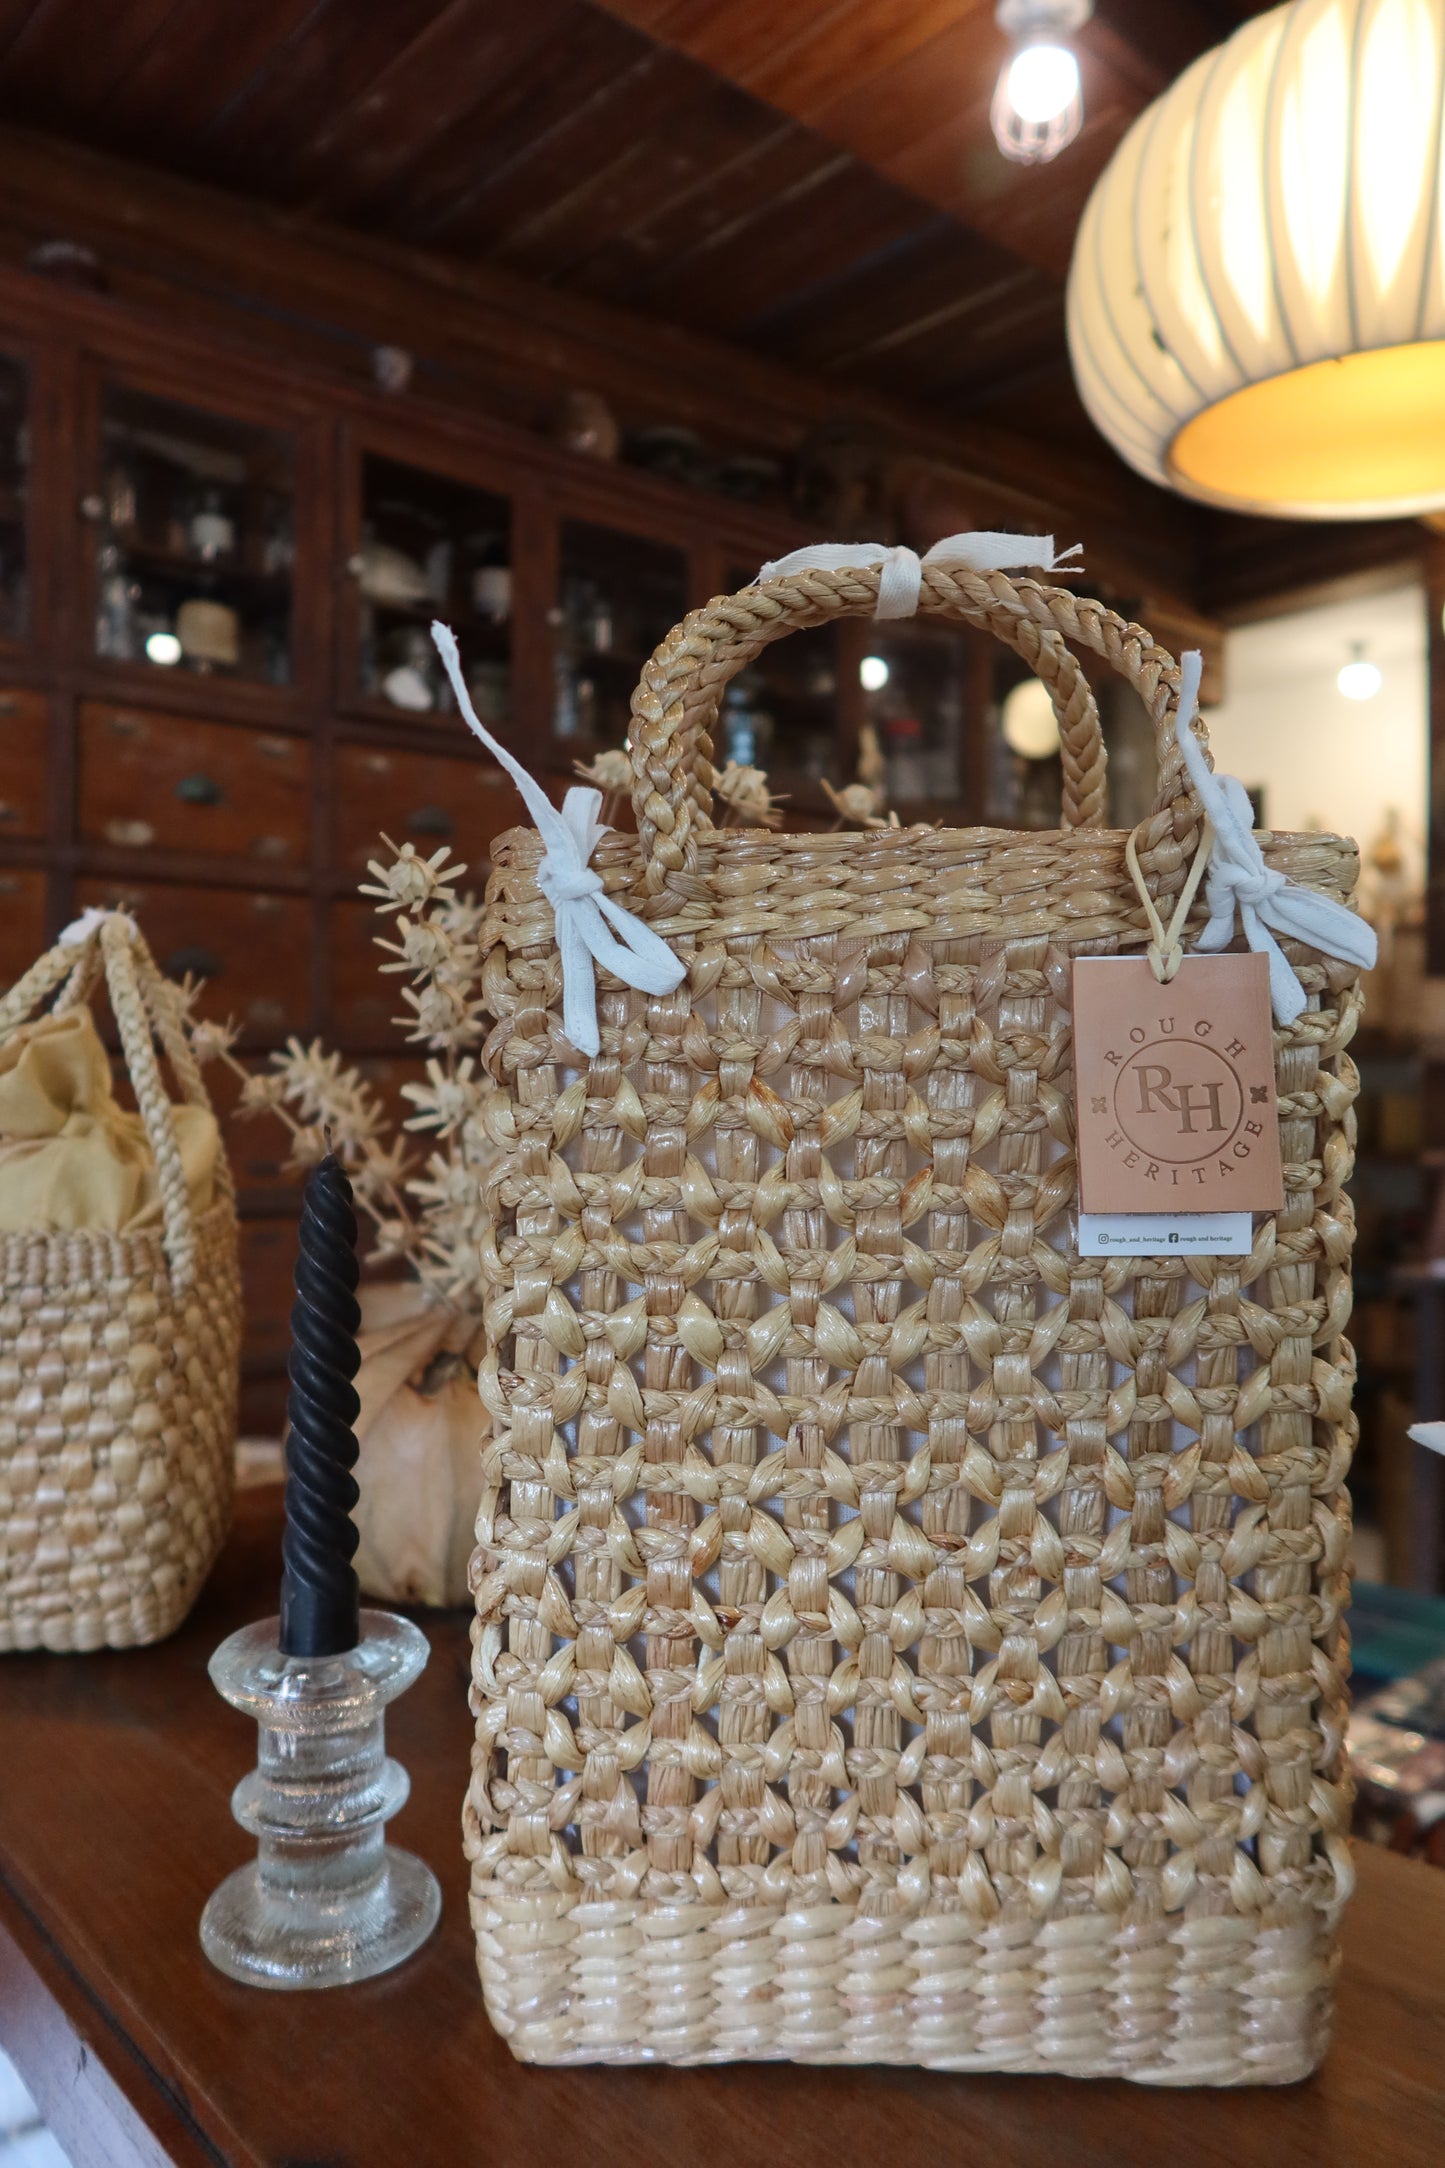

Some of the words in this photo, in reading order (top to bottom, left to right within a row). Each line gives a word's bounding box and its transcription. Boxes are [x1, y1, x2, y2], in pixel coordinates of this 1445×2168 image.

[1103, 1017, 1246, 1067] ROUGH
[1132, 1064, 1228, 1134] RH
[1104, 1120, 1263, 1186] HERITAGE
[1180, 1235, 1197, 1243] rough
[1209, 1235, 1233, 1243] heritage
